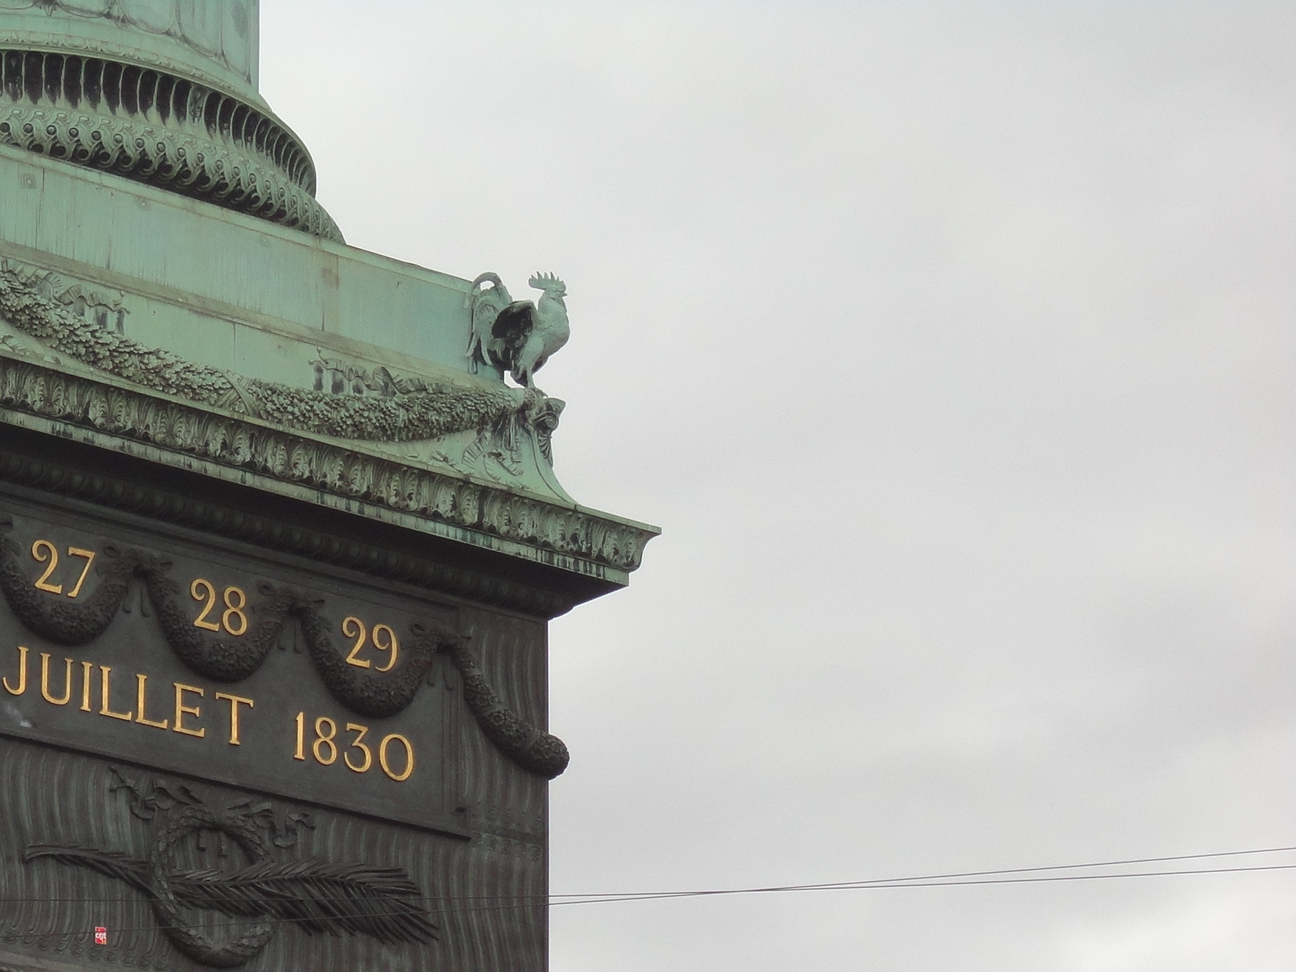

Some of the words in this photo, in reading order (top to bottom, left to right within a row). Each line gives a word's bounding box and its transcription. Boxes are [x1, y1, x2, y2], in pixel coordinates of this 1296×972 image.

[31, 539, 95, 598] 27
[189, 578, 248, 637] 28
[341, 616, 399, 672] 29
[2, 647, 254, 745] JUILLET
[293, 711, 415, 782] 1830
